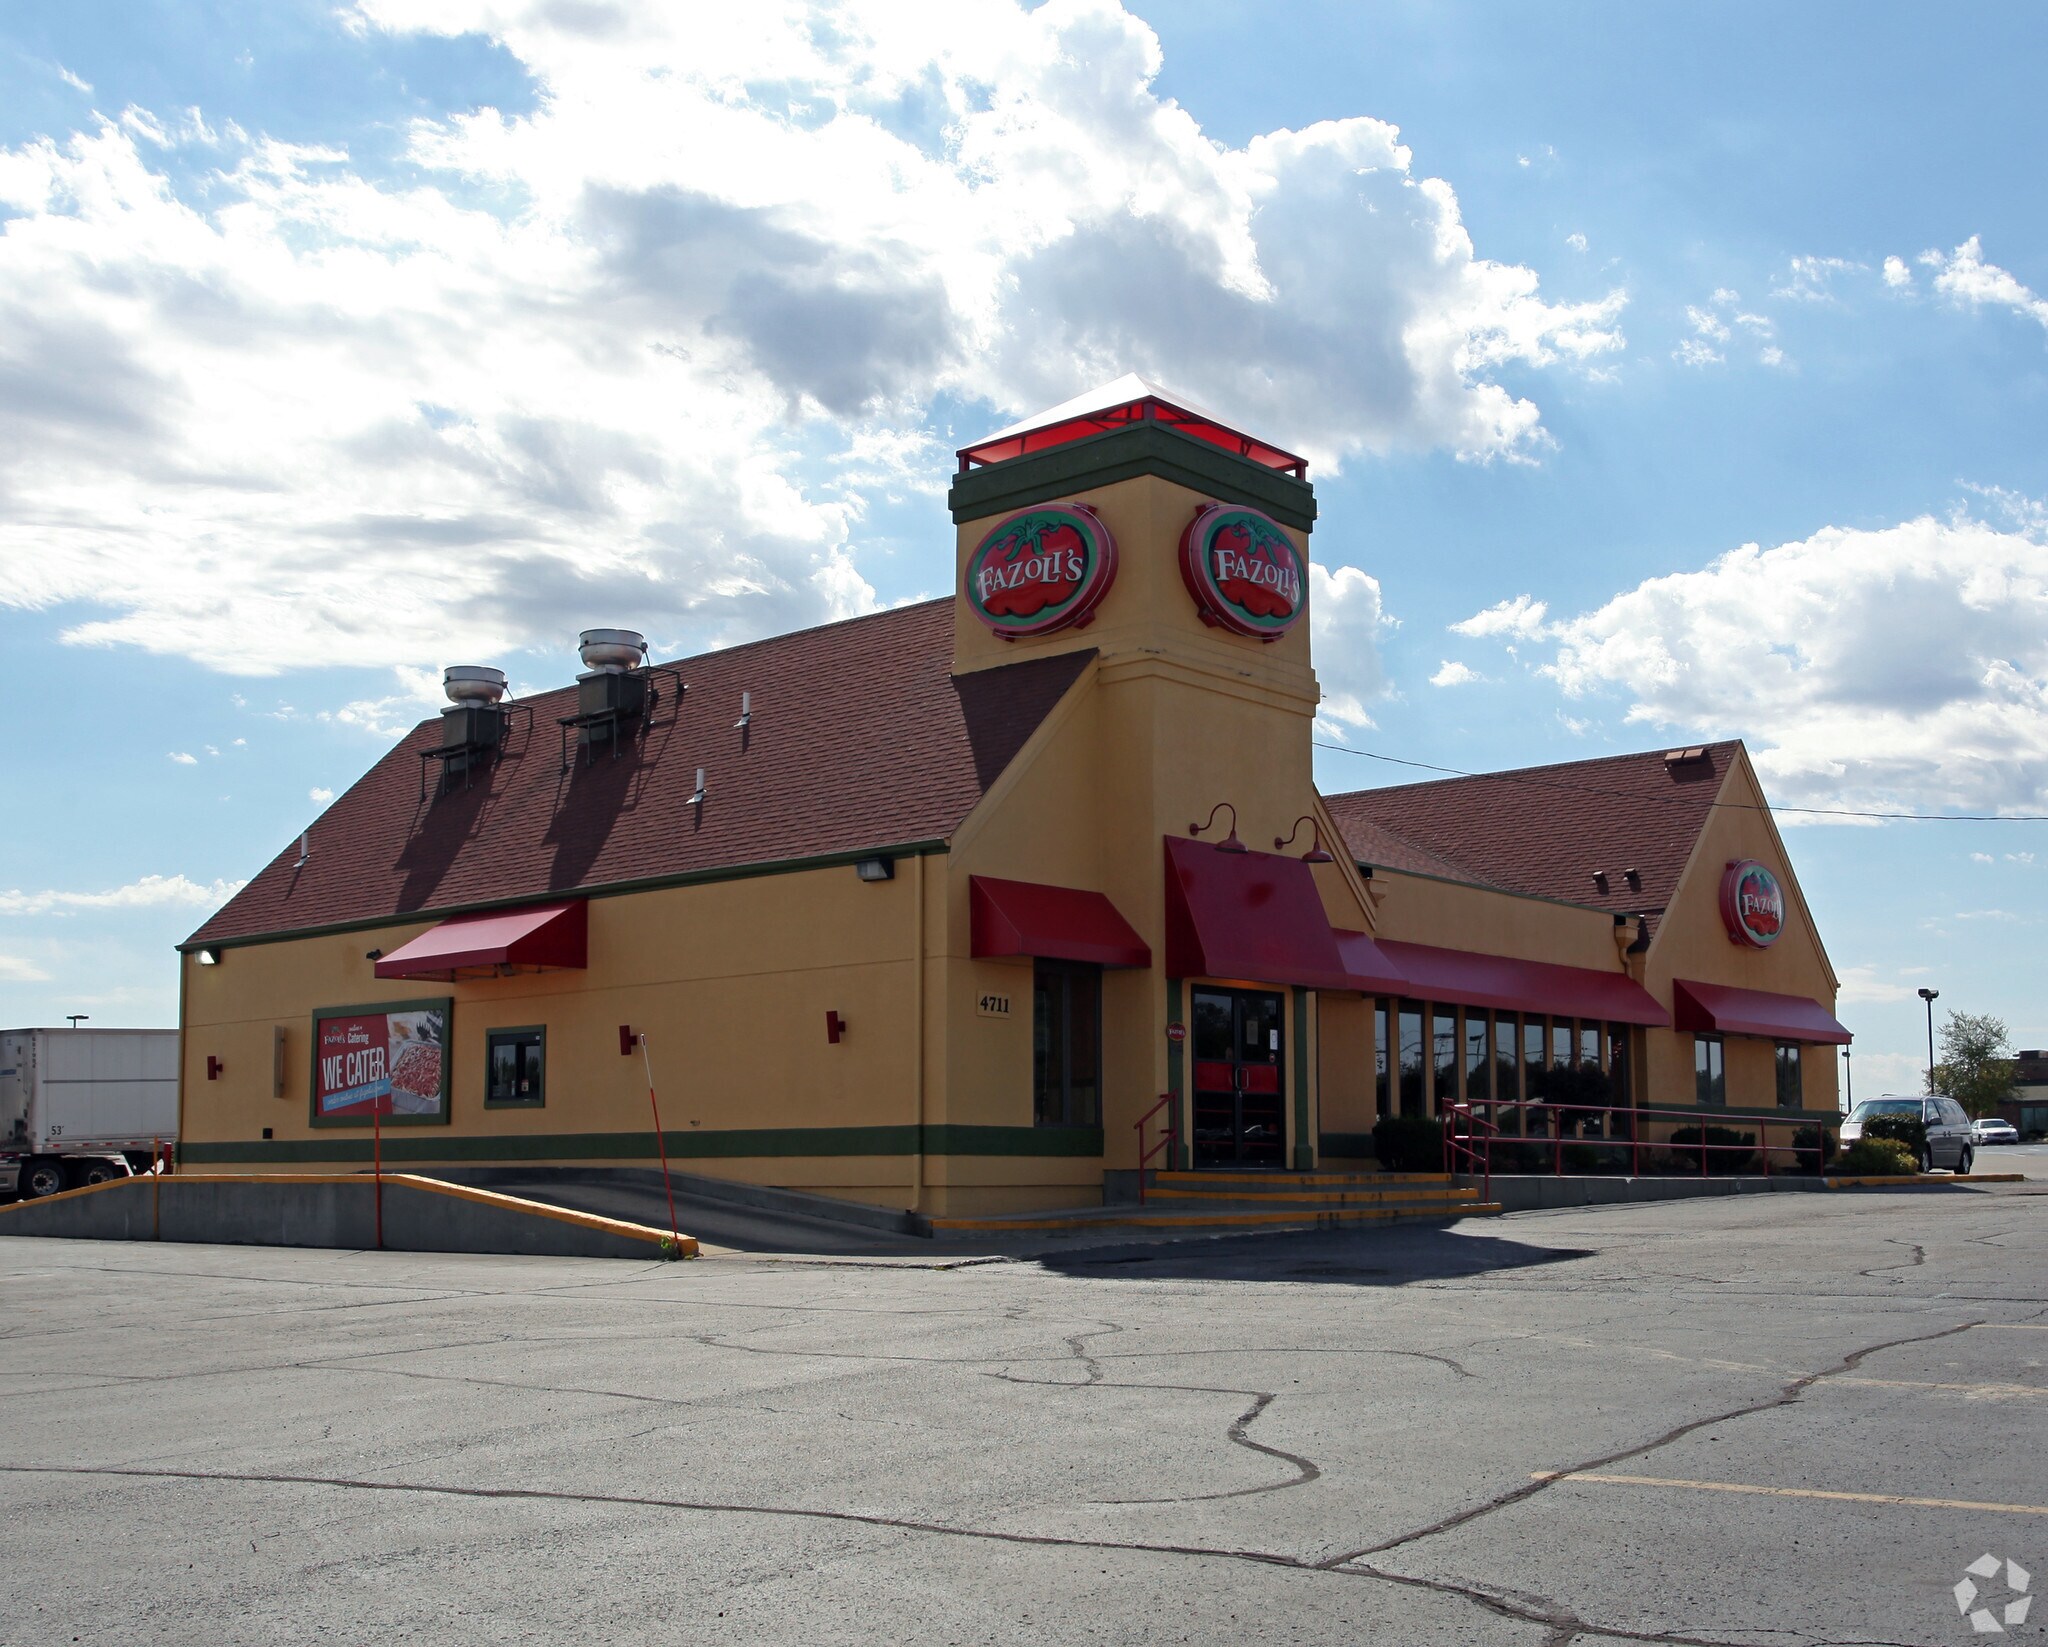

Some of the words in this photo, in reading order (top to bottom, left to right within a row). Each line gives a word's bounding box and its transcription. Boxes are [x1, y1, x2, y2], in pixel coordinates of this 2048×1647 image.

[978, 549, 1083, 603] FAZOLI'S
[1214, 549, 1300, 603] FAZOLI'S
[979, 995, 1009, 1013] 4711
[347, 1032, 369, 1045] Catering
[322, 1054, 344, 1091] WE
[346, 1046, 389, 1087] CATER.
[51, 1125, 64, 1136] 53'
